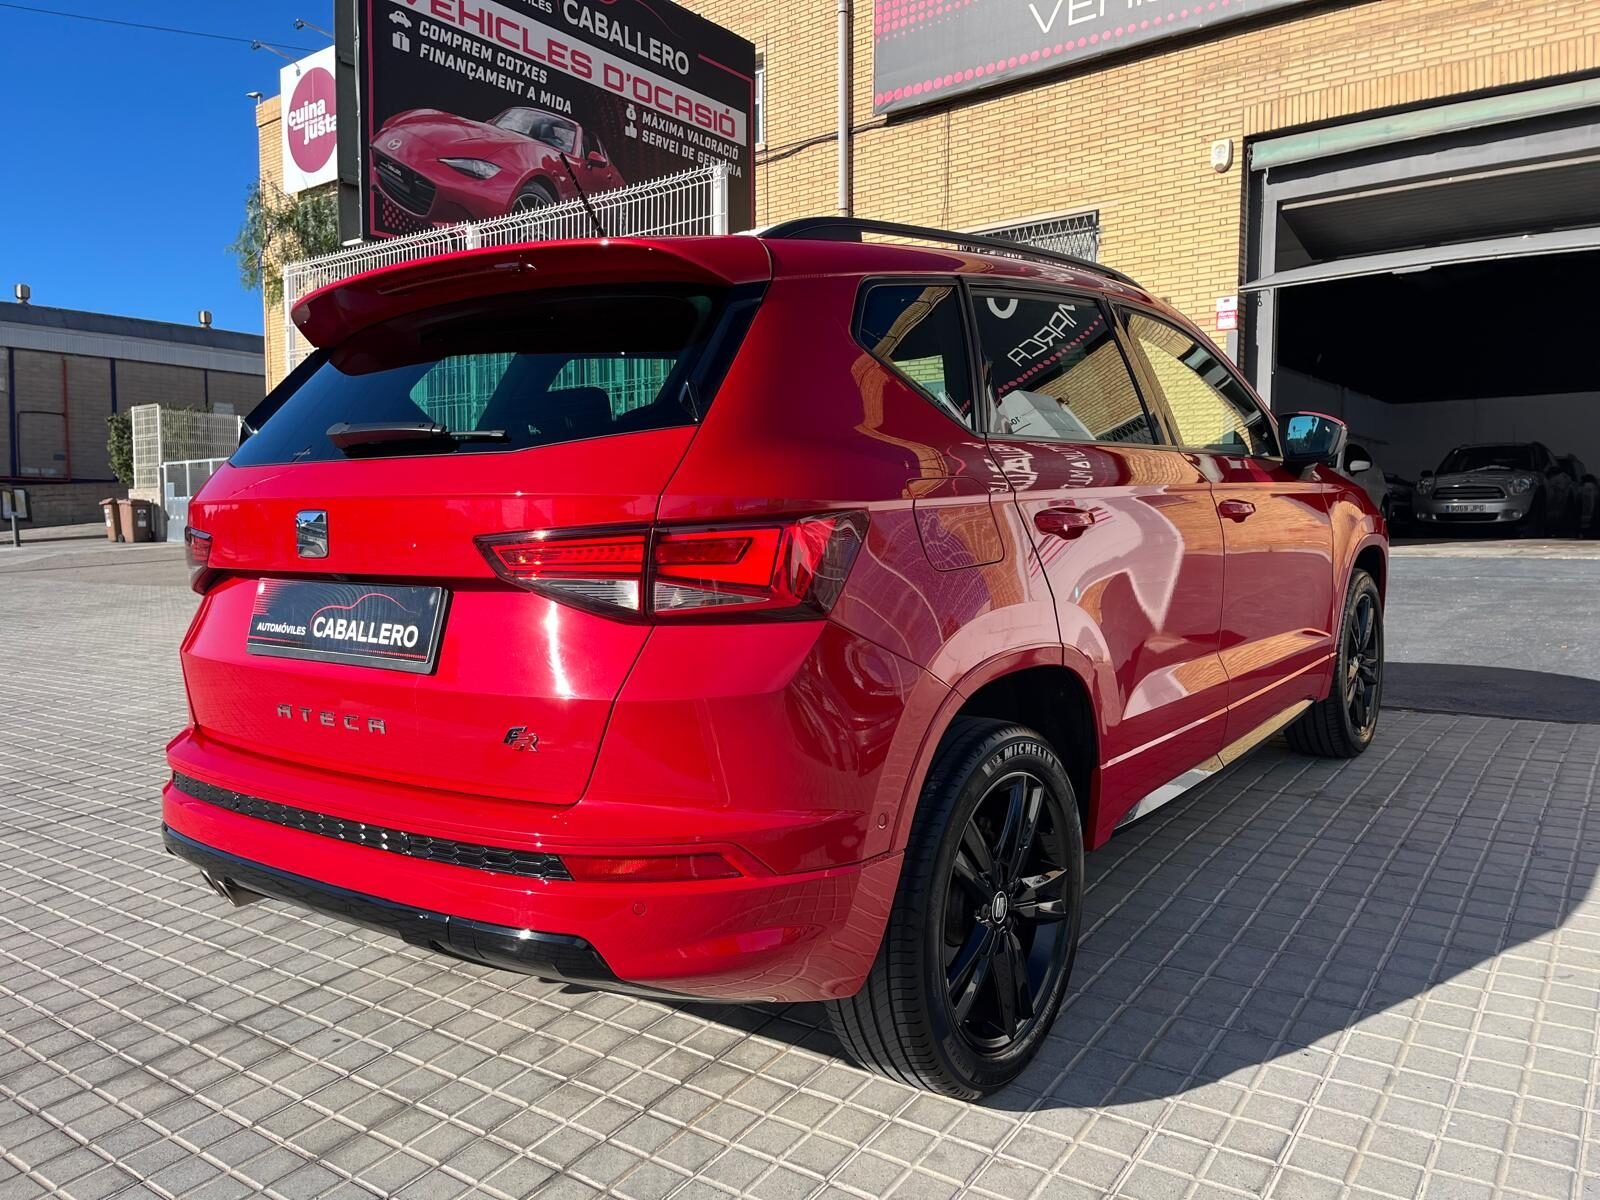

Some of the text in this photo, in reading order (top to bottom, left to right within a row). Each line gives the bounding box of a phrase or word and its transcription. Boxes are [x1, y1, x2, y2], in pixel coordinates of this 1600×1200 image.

[419, 20, 548, 84] COMPREM COTXES
[563, 0, 690, 75] CABALLERO
[406, 0, 736, 138] EHICLES D'OCASIÓ
[419, 43, 573, 114] FINANÇAMENT A MIDA
[288, 98, 326, 127] cuina
[642, 111, 739, 160] MÀXIMA VALORACIÓ
[642, 130, 679, 155] SERVEI
[682, 144, 695, 161] DE
[256, 616, 419, 648] AUTOMÓVILES CABALLERO
[277, 703, 387, 735] ATECA
[503, 726, 539, 752] FR
[1004, 743, 1054, 766] MICHELIN
